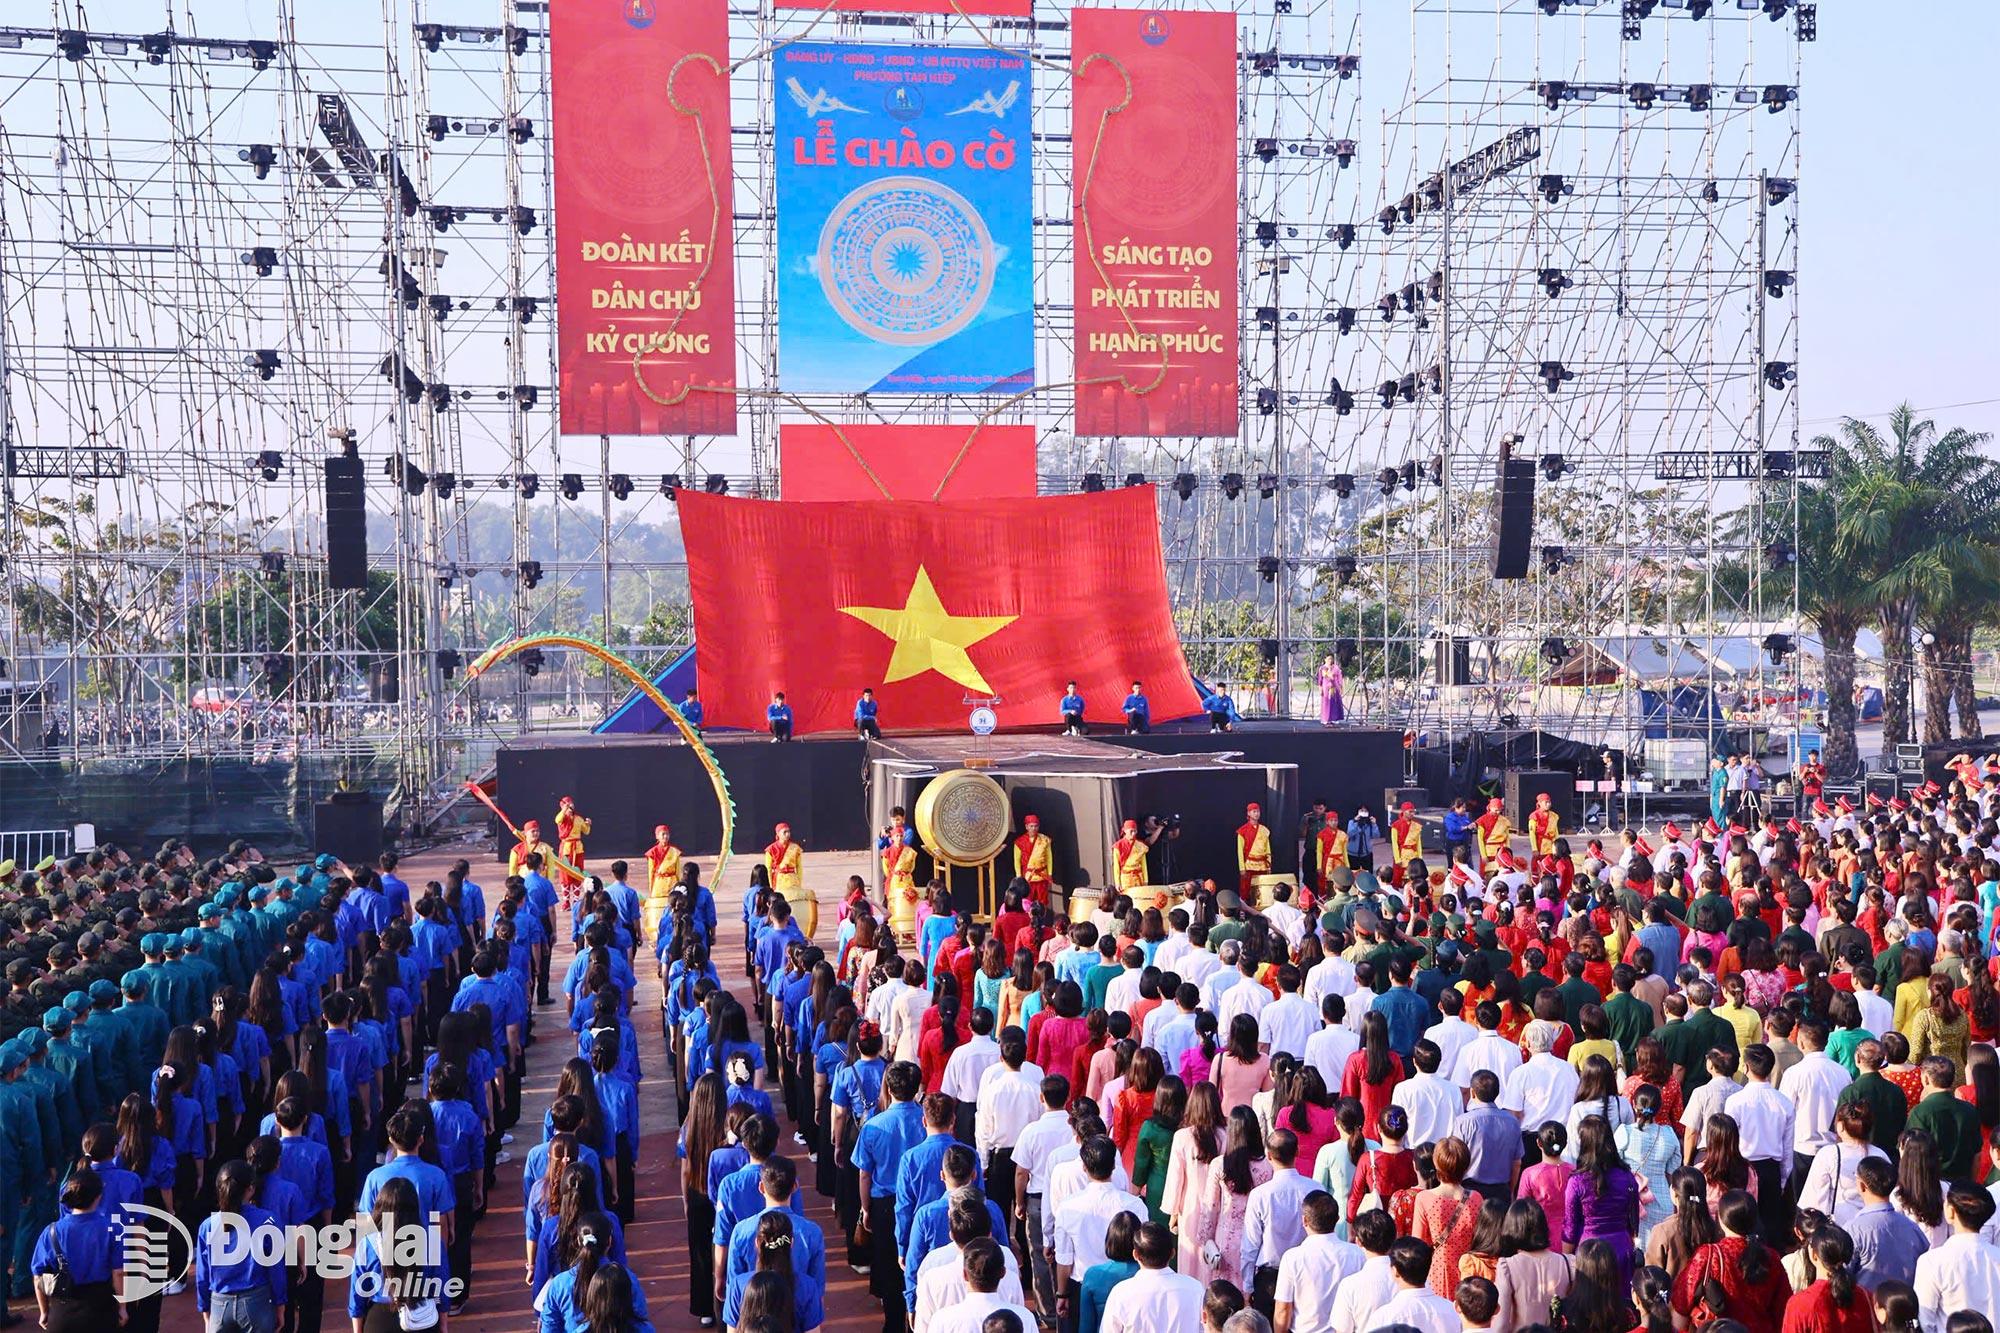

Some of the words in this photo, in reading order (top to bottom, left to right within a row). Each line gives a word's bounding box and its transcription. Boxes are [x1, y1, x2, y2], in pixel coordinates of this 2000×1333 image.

[794, 119, 837, 166] LỄ
[845, 127, 956, 168] CHÀO
[963, 128, 1016, 170] CỜ
[581, 232, 656, 263] ĐOÀN
[660, 229, 706, 263] KẾT
[1102, 236, 1164, 266] SÁNG
[1166, 246, 1213, 273] TẠO
[592, 280, 645, 310] DÂN
[649, 281, 701, 311] CHỦ
[1091, 280, 1152, 308] PHÁT
[1154, 275, 1220, 309] TRIỂN
[586, 324, 621, 353] KỶ
[623, 331, 711, 354] CƯƠNG
[1089, 332, 1158, 359] HẠNH
[1161, 324, 1224, 353] PHÚC
